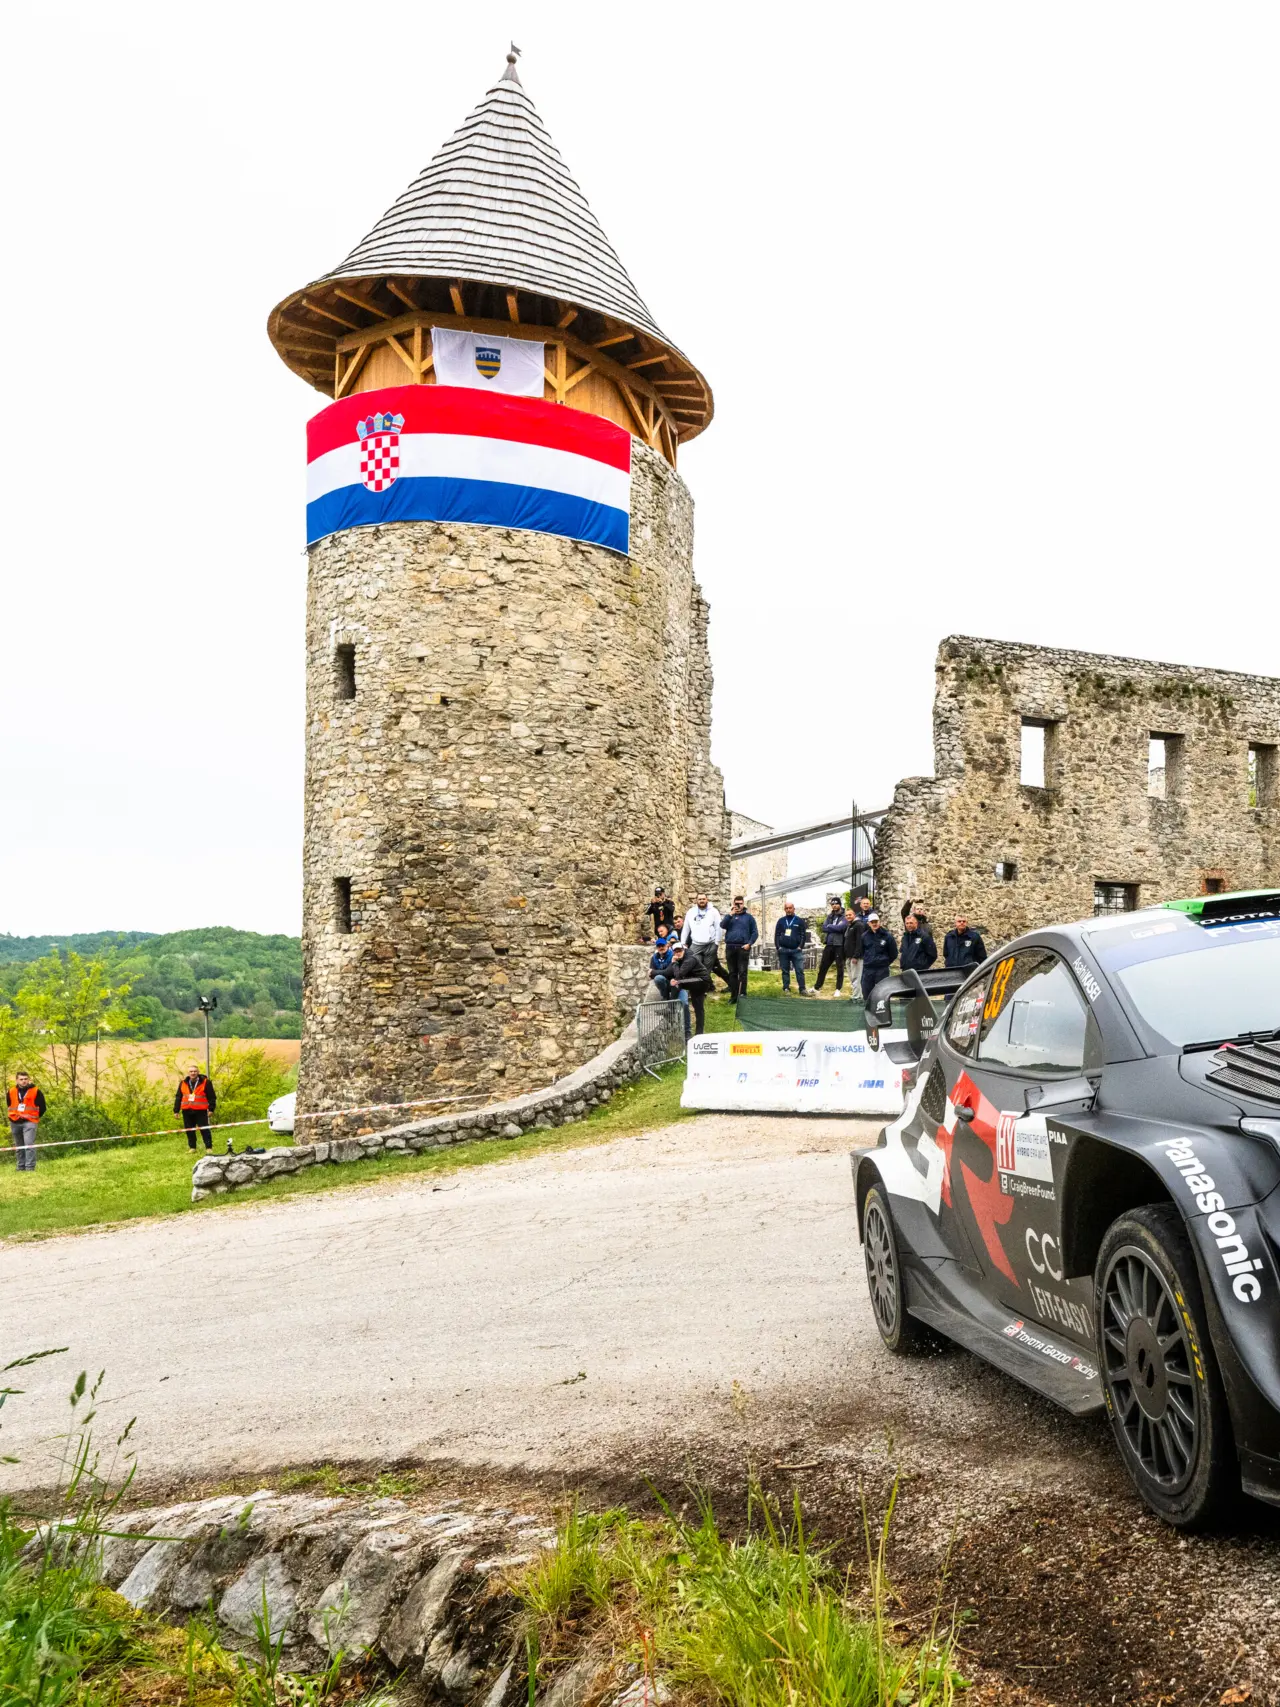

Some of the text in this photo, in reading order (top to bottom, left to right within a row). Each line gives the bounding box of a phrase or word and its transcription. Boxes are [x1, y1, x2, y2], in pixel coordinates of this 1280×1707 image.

[984, 957, 1015, 1019] 33
[1048, 1130, 1068, 1145] PIAA
[1155, 1137, 1264, 1303] Panasonic
[1016, 1330, 1045, 1350] TOYOTA
[1041, 1345, 1072, 1364] GAZOO
